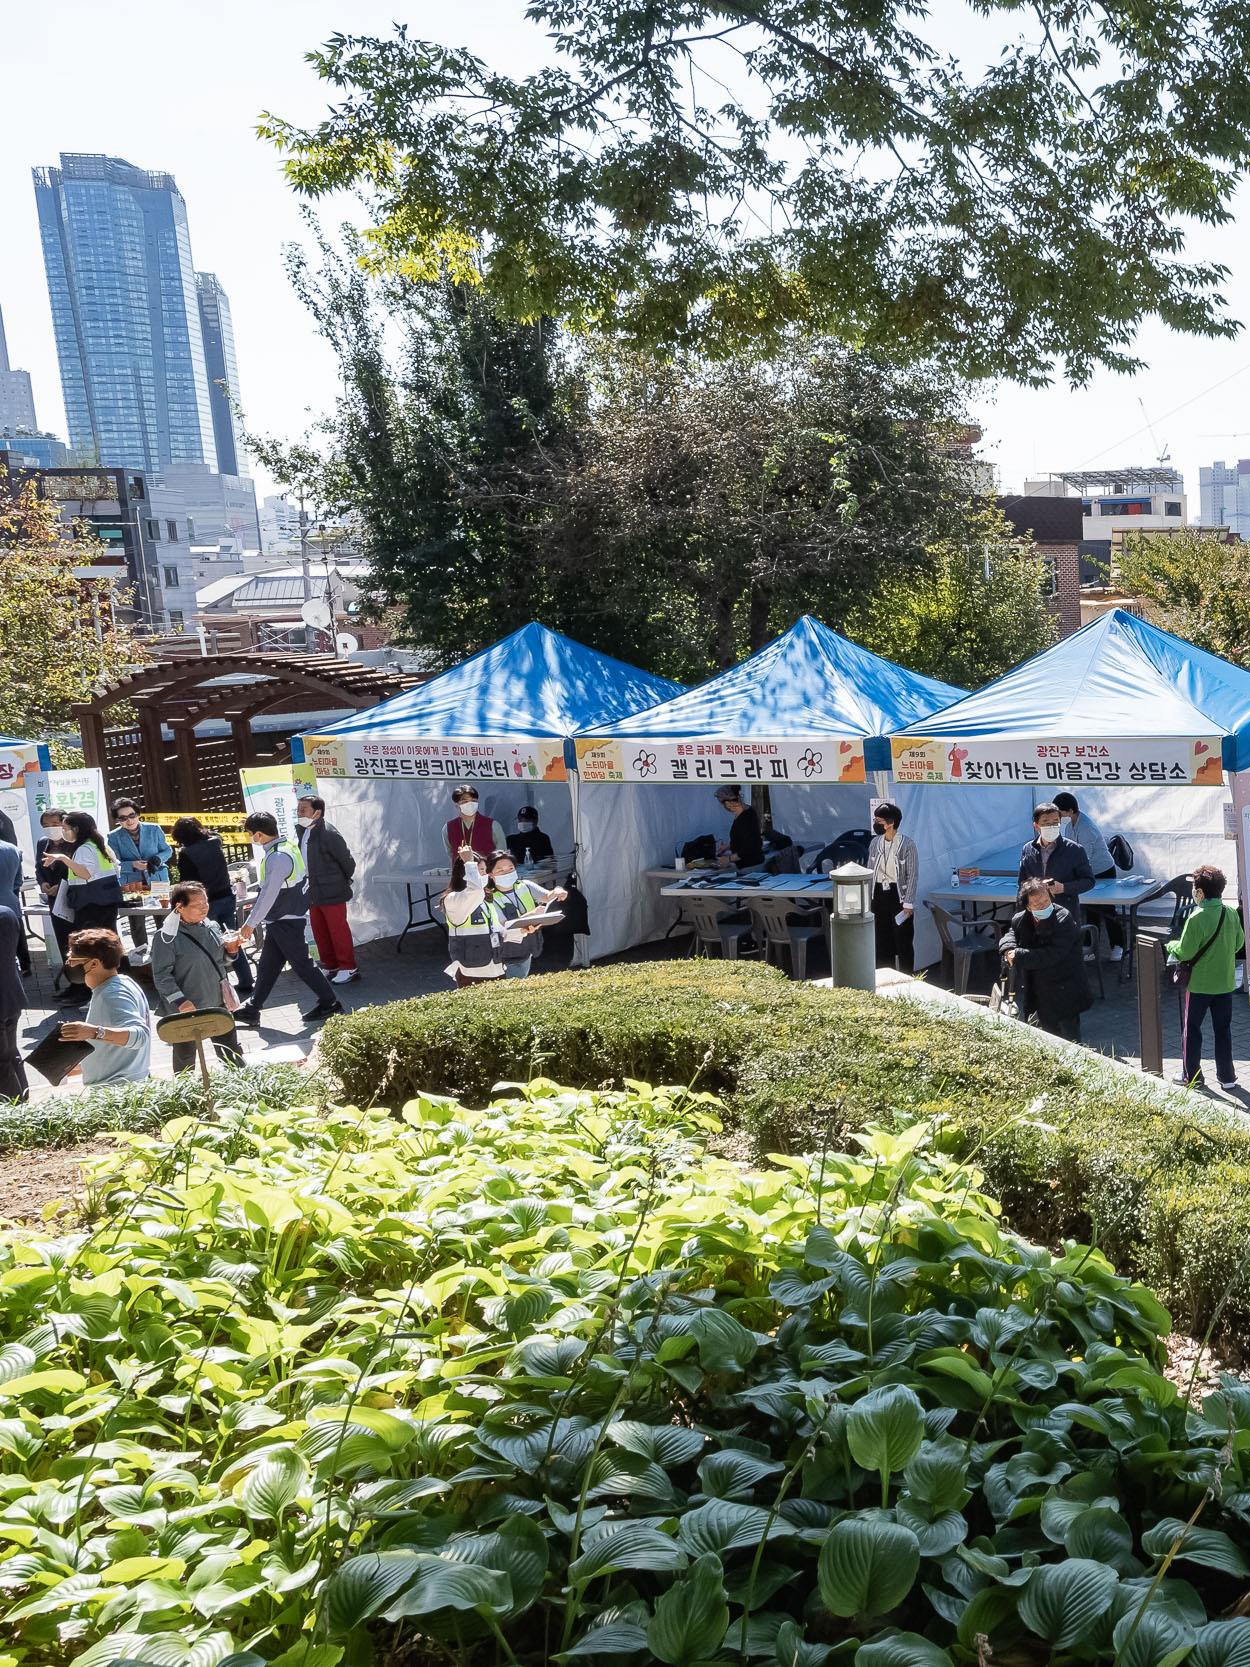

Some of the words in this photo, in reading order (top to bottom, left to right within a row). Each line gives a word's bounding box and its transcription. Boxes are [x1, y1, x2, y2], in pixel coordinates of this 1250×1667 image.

[363, 745, 379, 755] 작은
[381, 745, 405, 755] 정성이
[407, 745, 440, 756] 이웃에게
[441, 746, 450, 756] 큰
[452, 746, 468, 756] 힘이
[471, 746, 494, 757] 됩니다
[677, 744, 694, 755] 좋은
[697, 744, 723, 755] 글귀를
[726, 744, 778, 755] 적어드립니다
[1037, 745, 1071, 758] 광진구
[1075, 745, 1110, 758] 보건소
[354, 758, 510, 778] 광진푸드뱅크마켓센터
[585, 760, 614, 770] 느티마을
[901, 760, 934, 771] 느티마을
[965, 760, 1039, 780] 찾아가는
[1046, 761, 1121, 781] 마음건강
[1128, 762, 1187, 781] 상담소
[315, 767, 330, 775] 마당
[583, 771, 606, 779] 한마당
[608, 771, 623, 779] 축제
[898, 771, 923, 780] 한마당
[926, 771, 944, 781] 축제
[35, 791, 97, 812] 친환경
